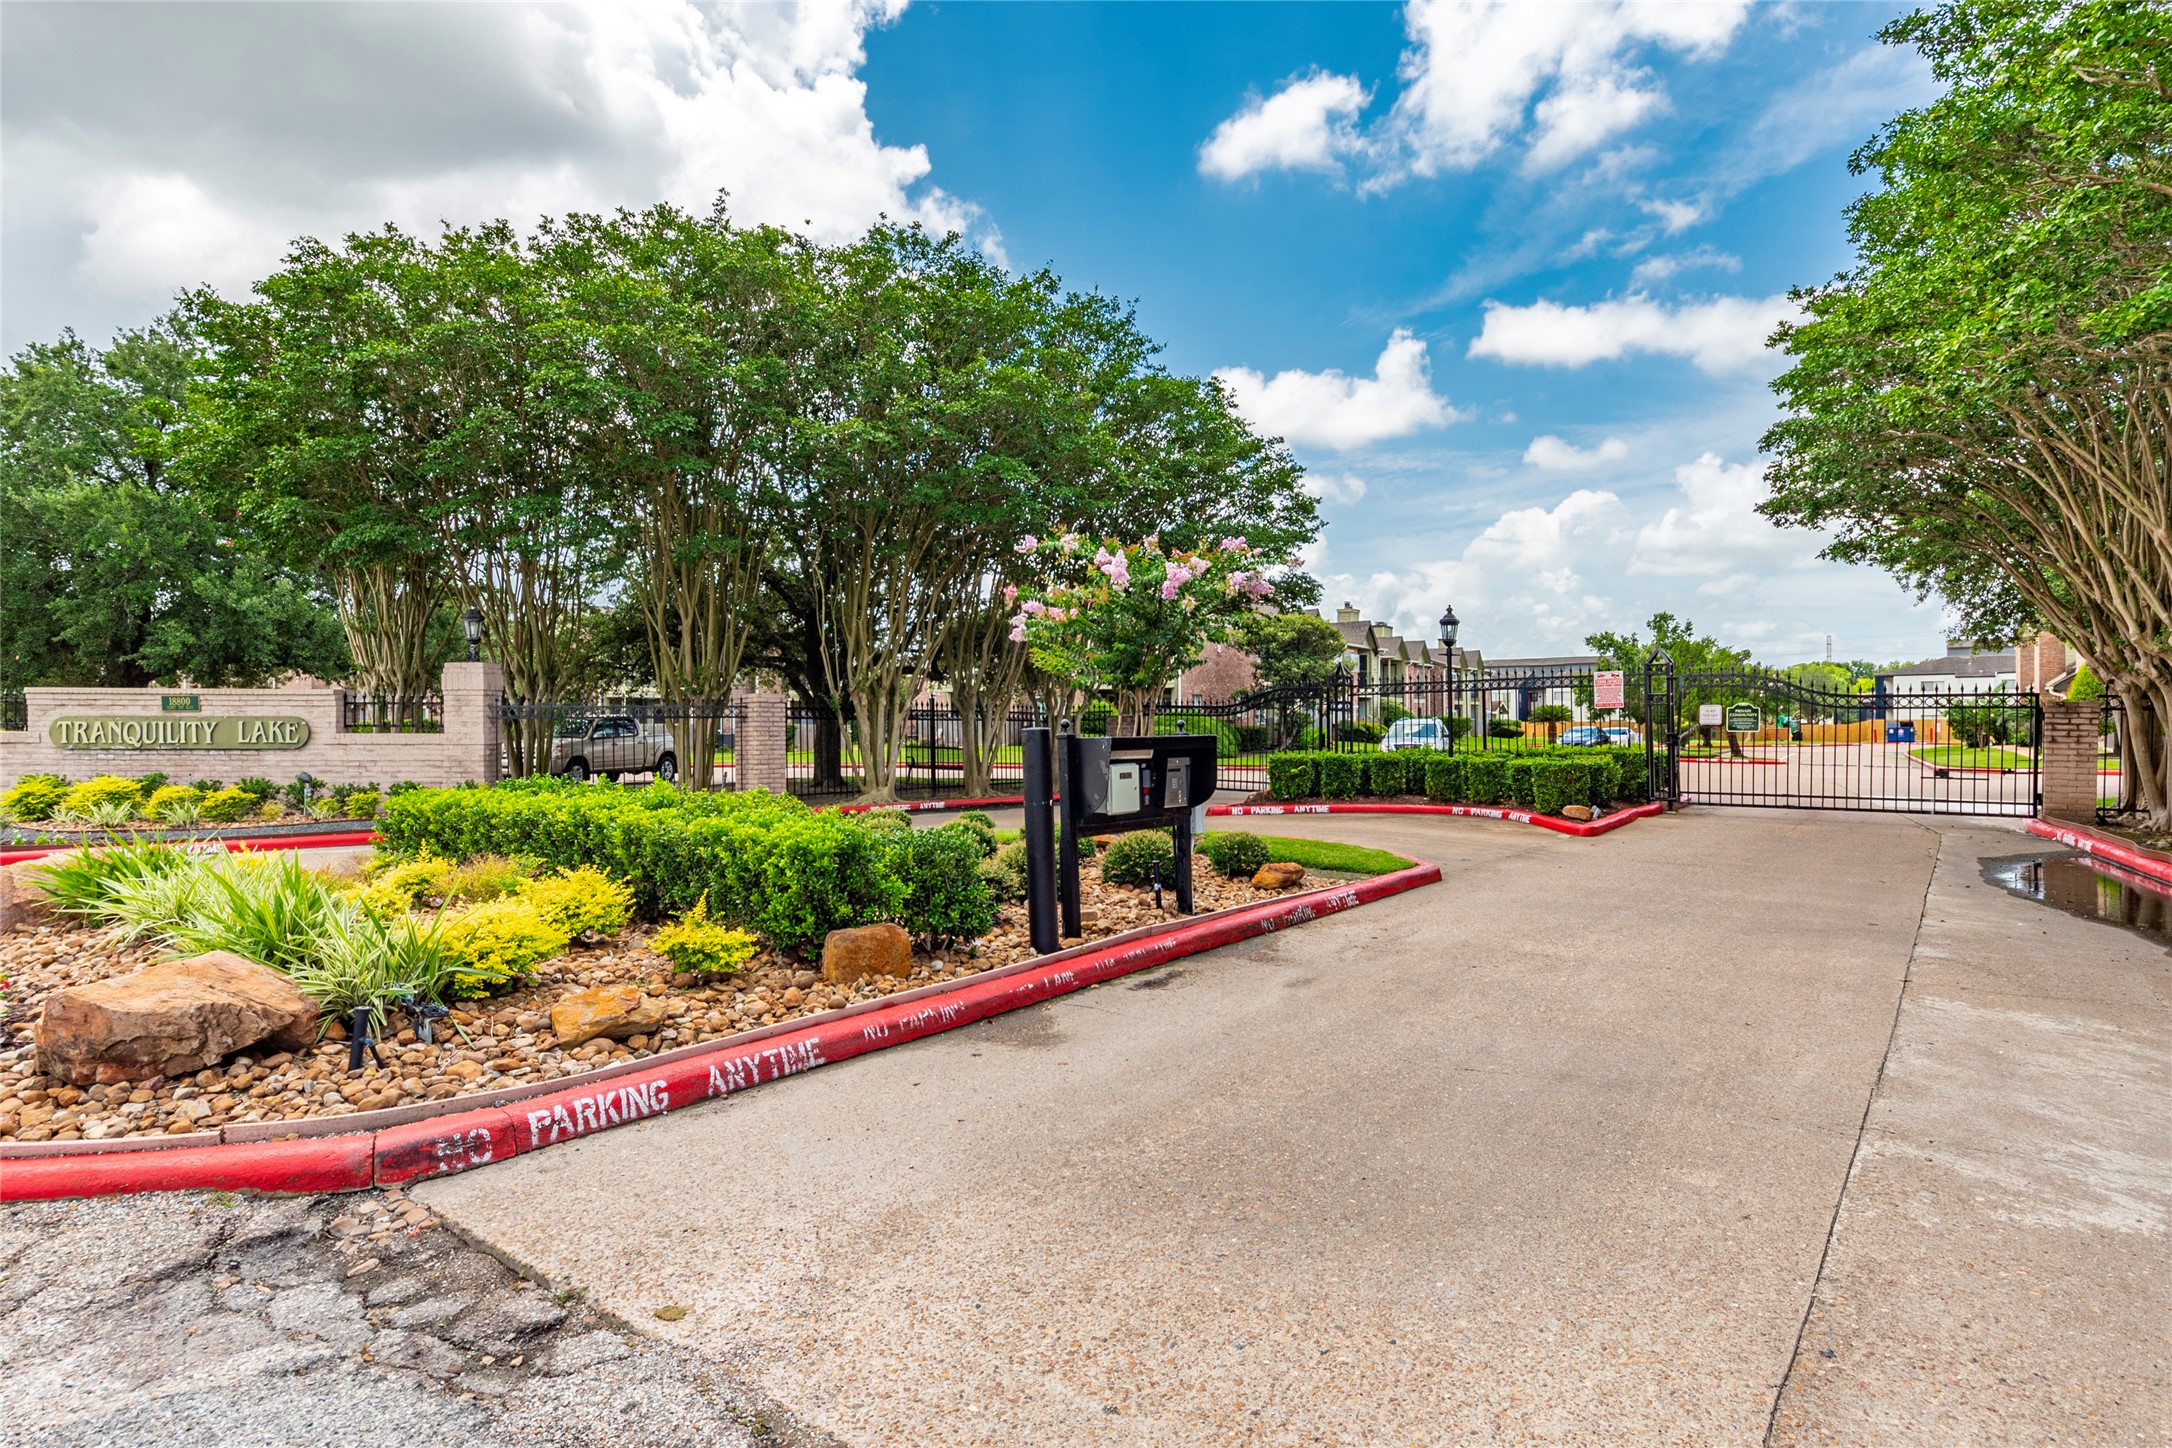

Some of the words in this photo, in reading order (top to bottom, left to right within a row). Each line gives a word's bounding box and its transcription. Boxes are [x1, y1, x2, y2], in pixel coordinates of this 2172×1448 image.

[169, 697, 191, 706] 18800
[56, 720, 218, 747] TRANQUILITY
[238, 720, 300, 744] LAKE
[1231, 807, 1244, 815] NO
[1250, 806, 1285, 815] PARKING
[1294, 805, 1330, 813] ANYTIME
[1452, 806, 1464, 815] NO
[1470, 808, 1503, 819] PARKING
[526, 1079, 669, 1147] PARKING
[707, 1037, 826, 1097] ANYTIME
